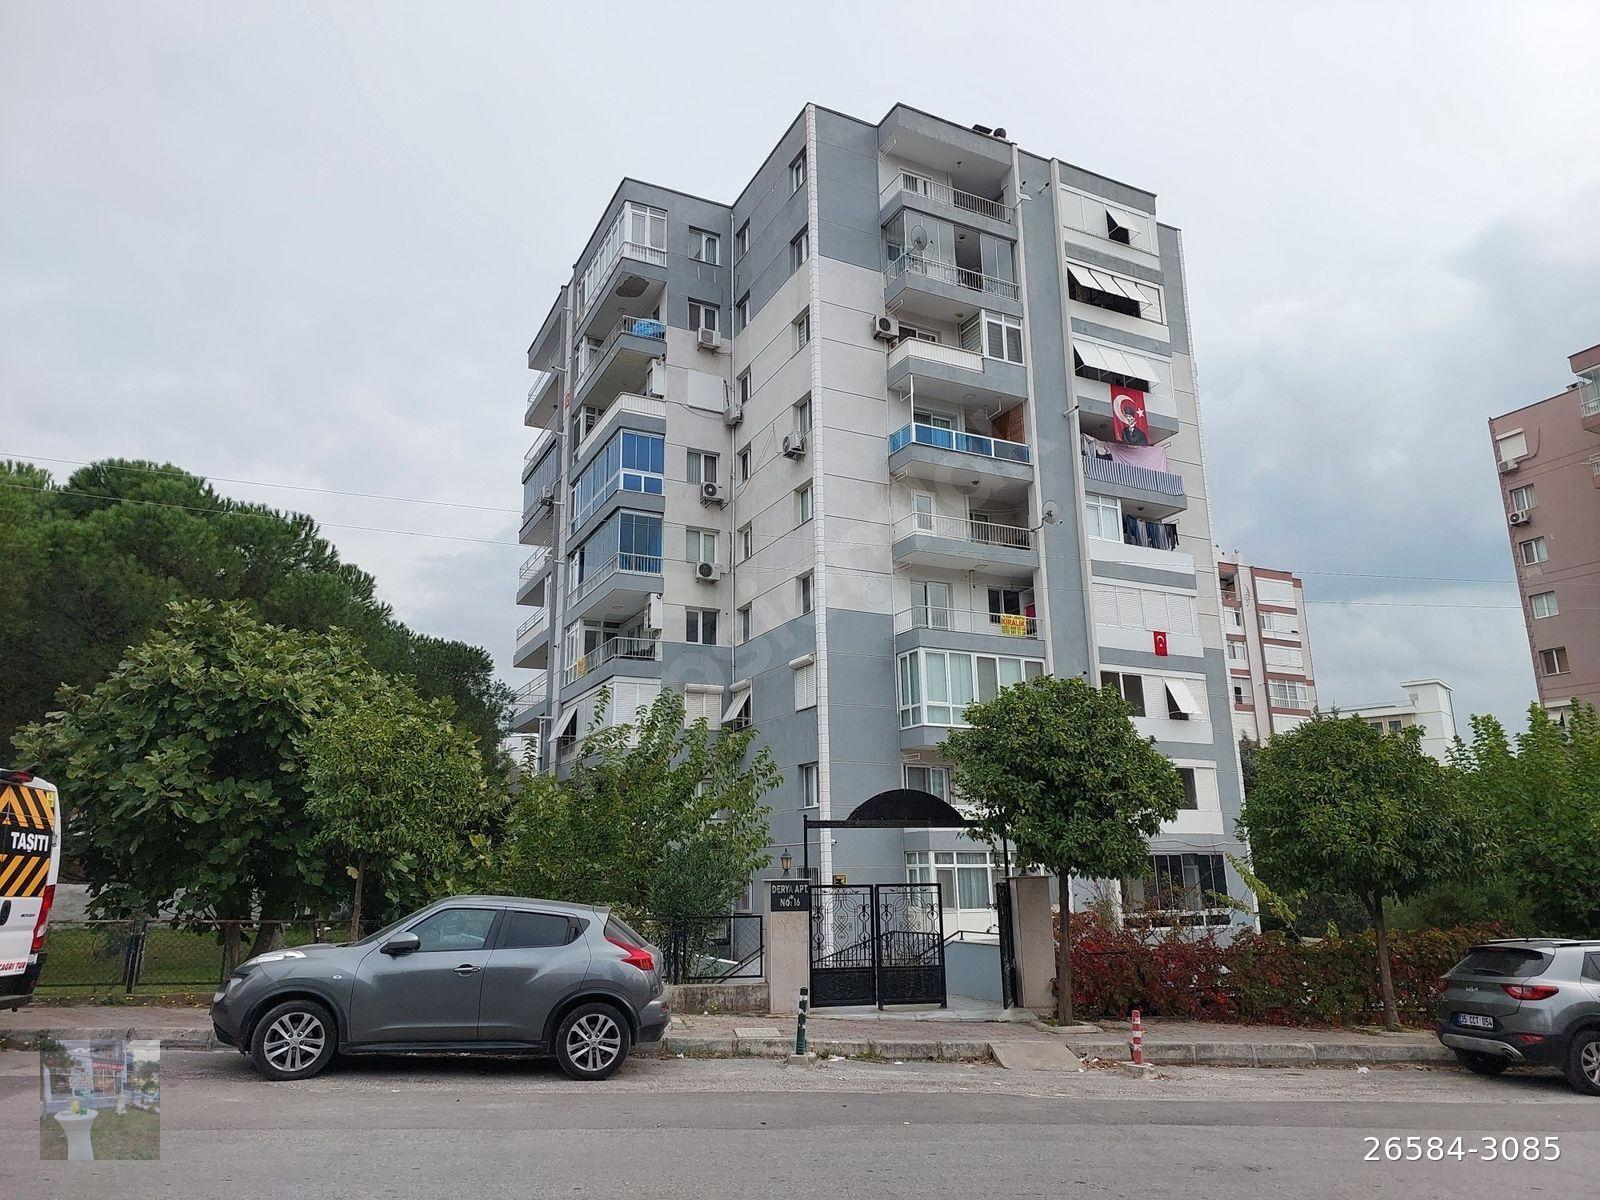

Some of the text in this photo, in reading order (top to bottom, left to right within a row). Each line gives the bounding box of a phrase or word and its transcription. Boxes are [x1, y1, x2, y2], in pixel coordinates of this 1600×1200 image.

[1002, 618, 1025, 627] KIRALIK
[10, 832, 49, 852] TAŞITI
[772, 884, 793, 894] DERYA
